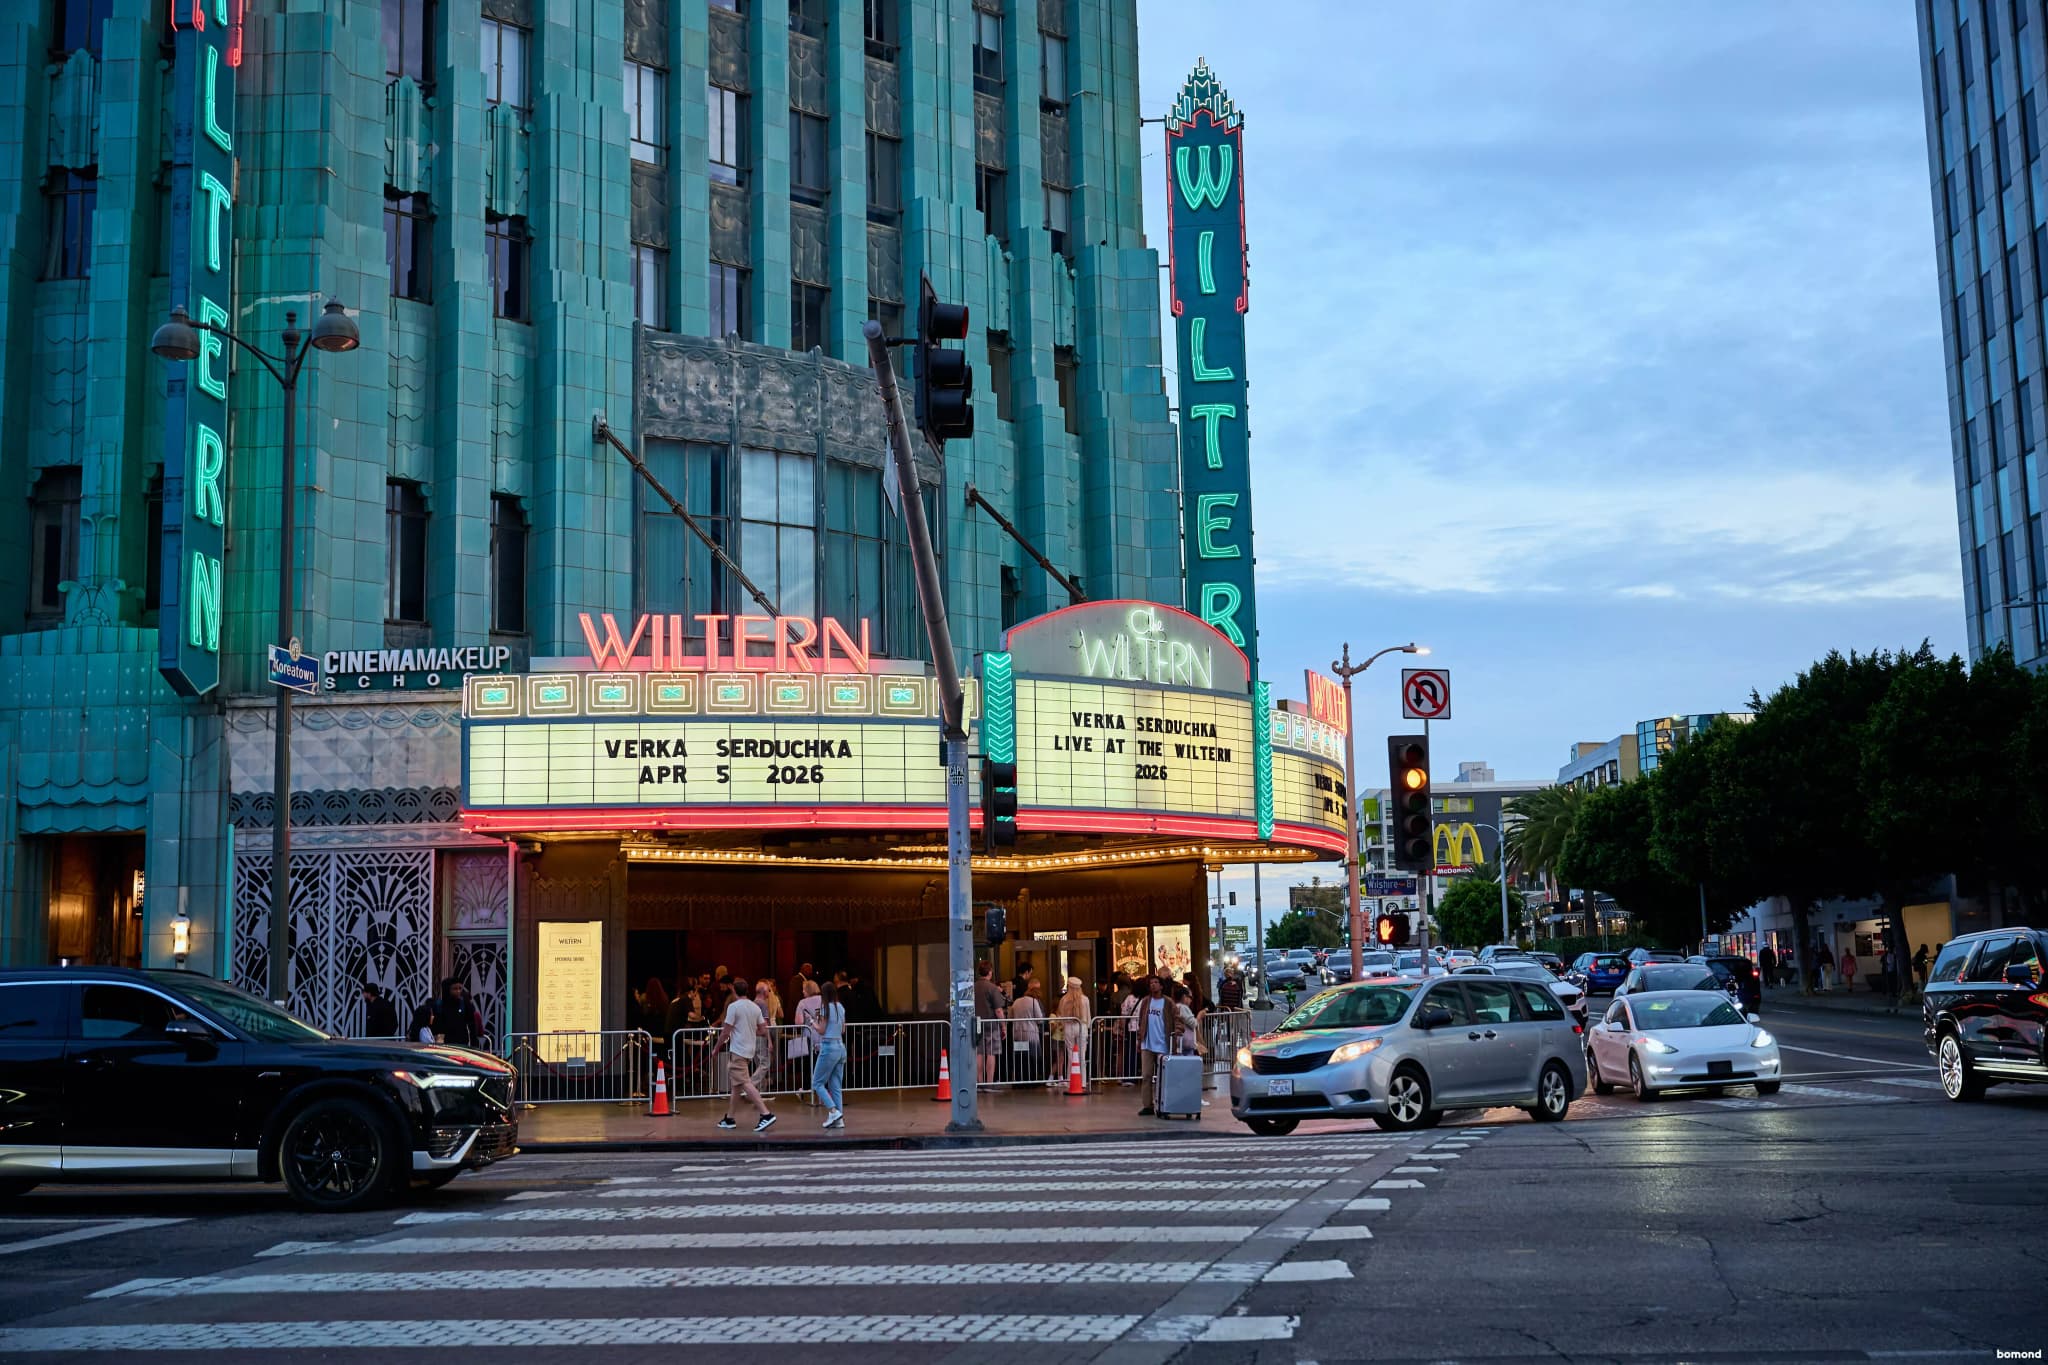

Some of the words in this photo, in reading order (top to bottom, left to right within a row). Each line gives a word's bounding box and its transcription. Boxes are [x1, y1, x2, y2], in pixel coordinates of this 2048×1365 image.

[189, 0, 232, 653] LTERN
[578, 612, 870, 674] WILTERN
[273, 656, 316, 683] Koreatown
[323, 645, 511, 674] CINEMAMAKEUP
[1079, 629, 1213, 689] WILTERN
[1071, 711, 1126, 730] VERKA
[1136, 716, 1217, 738] SERDUCHKA
[605, 738, 688, 759] VERKA
[716, 738, 853, 759] SERDUCHKA
[1054, 735, 1093, 752] LIVE
[1105, 738, 1125, 754] AT
[1137, 740, 1163, 757] THE
[1175, 745, 1232, 763] WILTERN
[639, 765, 688, 785] APR
[716, 765, 730, 784] 5
[766, 765, 824, 785] 2026
[1135, 764, 1168, 781] 2026
[1367, 879, 1398, 889] Wilshire
